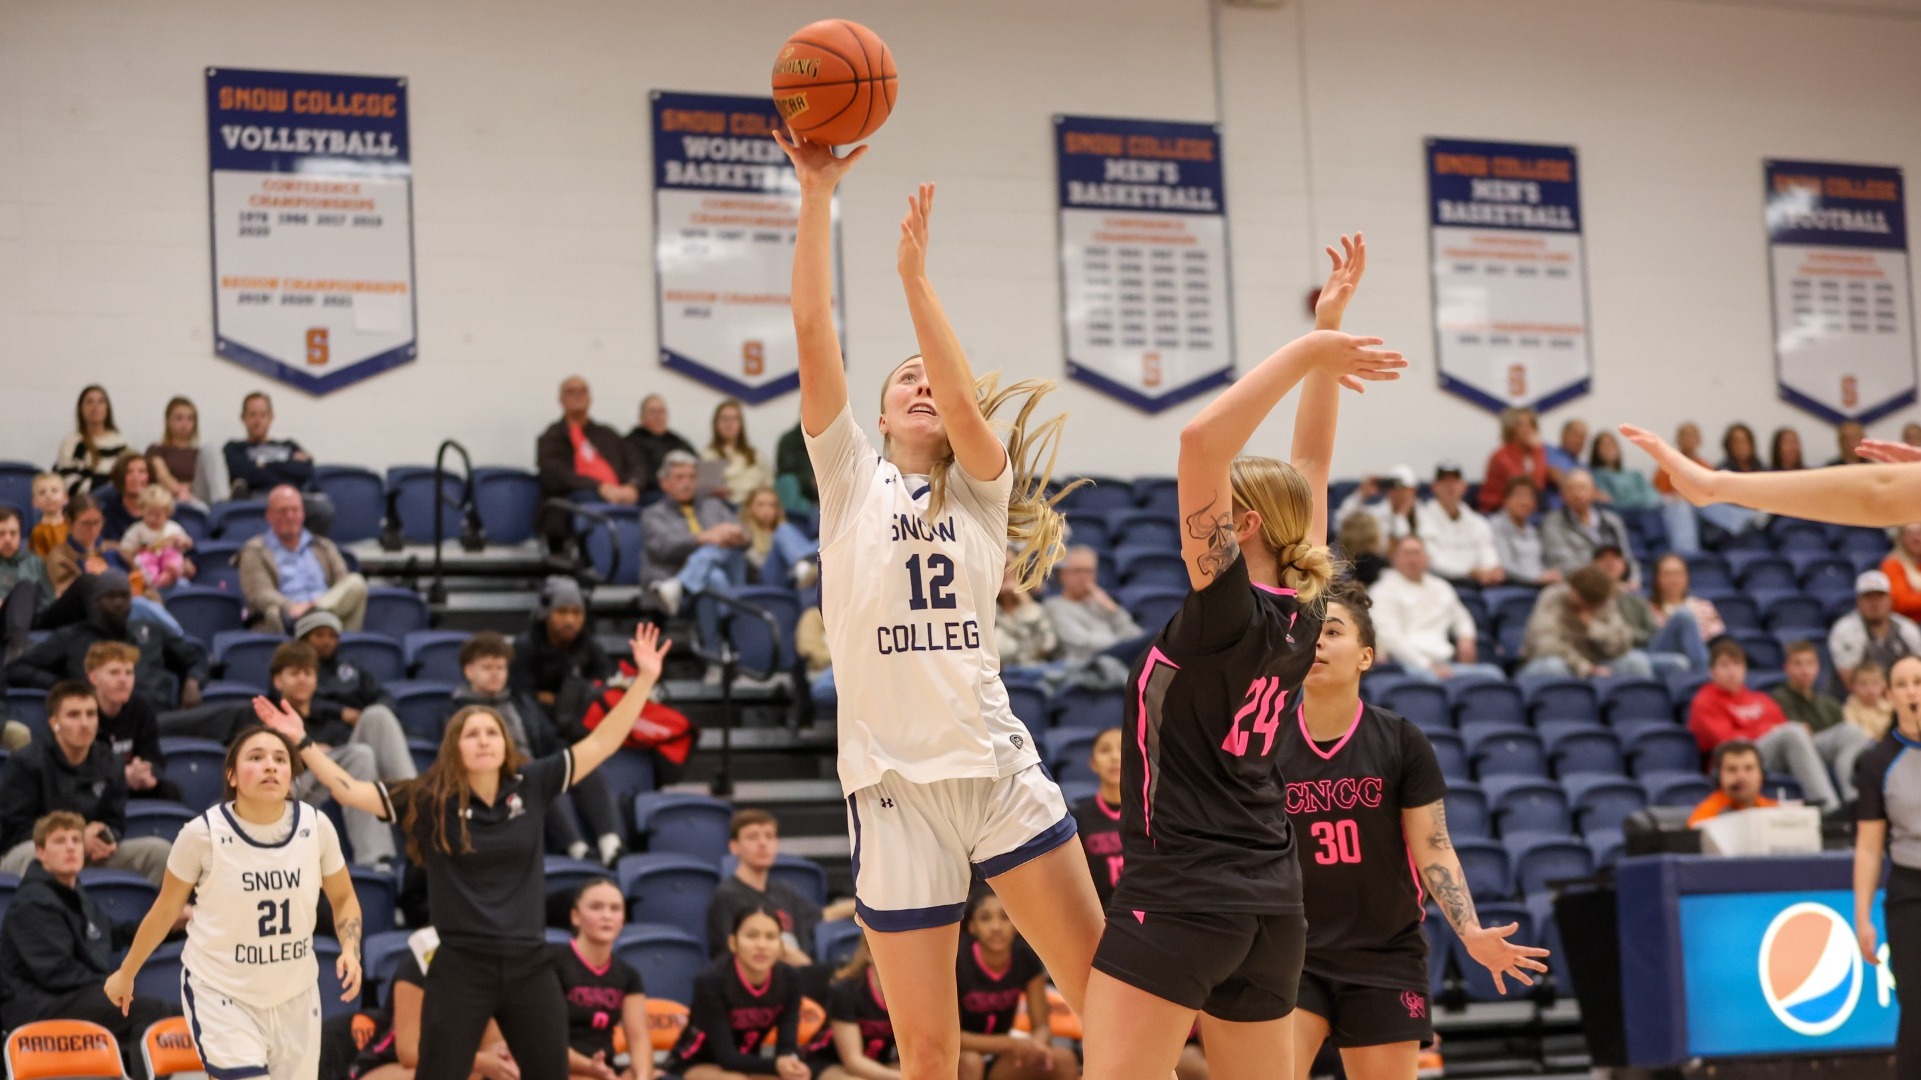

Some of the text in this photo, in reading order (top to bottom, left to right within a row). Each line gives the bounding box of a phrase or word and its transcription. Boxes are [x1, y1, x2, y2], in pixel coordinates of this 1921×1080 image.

[219, 86, 398, 118] SNOW COLLEGE
[220, 124, 399, 157] VOLLEYBALL
[730, 112, 792, 138] COLL
[1104, 158, 1180, 185] MEN'S
[1067, 180, 1218, 211] BASKETBALL
[905, 553, 957, 611] 12
[877, 620, 980, 655] COLLEG
[1221, 676, 1289, 757] 24
[1284, 777, 1383, 814] CNCC
[1310, 819, 1362, 866] 30
[242, 868, 301, 892] SNOW
[257, 898, 292, 938] 21
[18, 1032, 109, 1053] BADGERS
